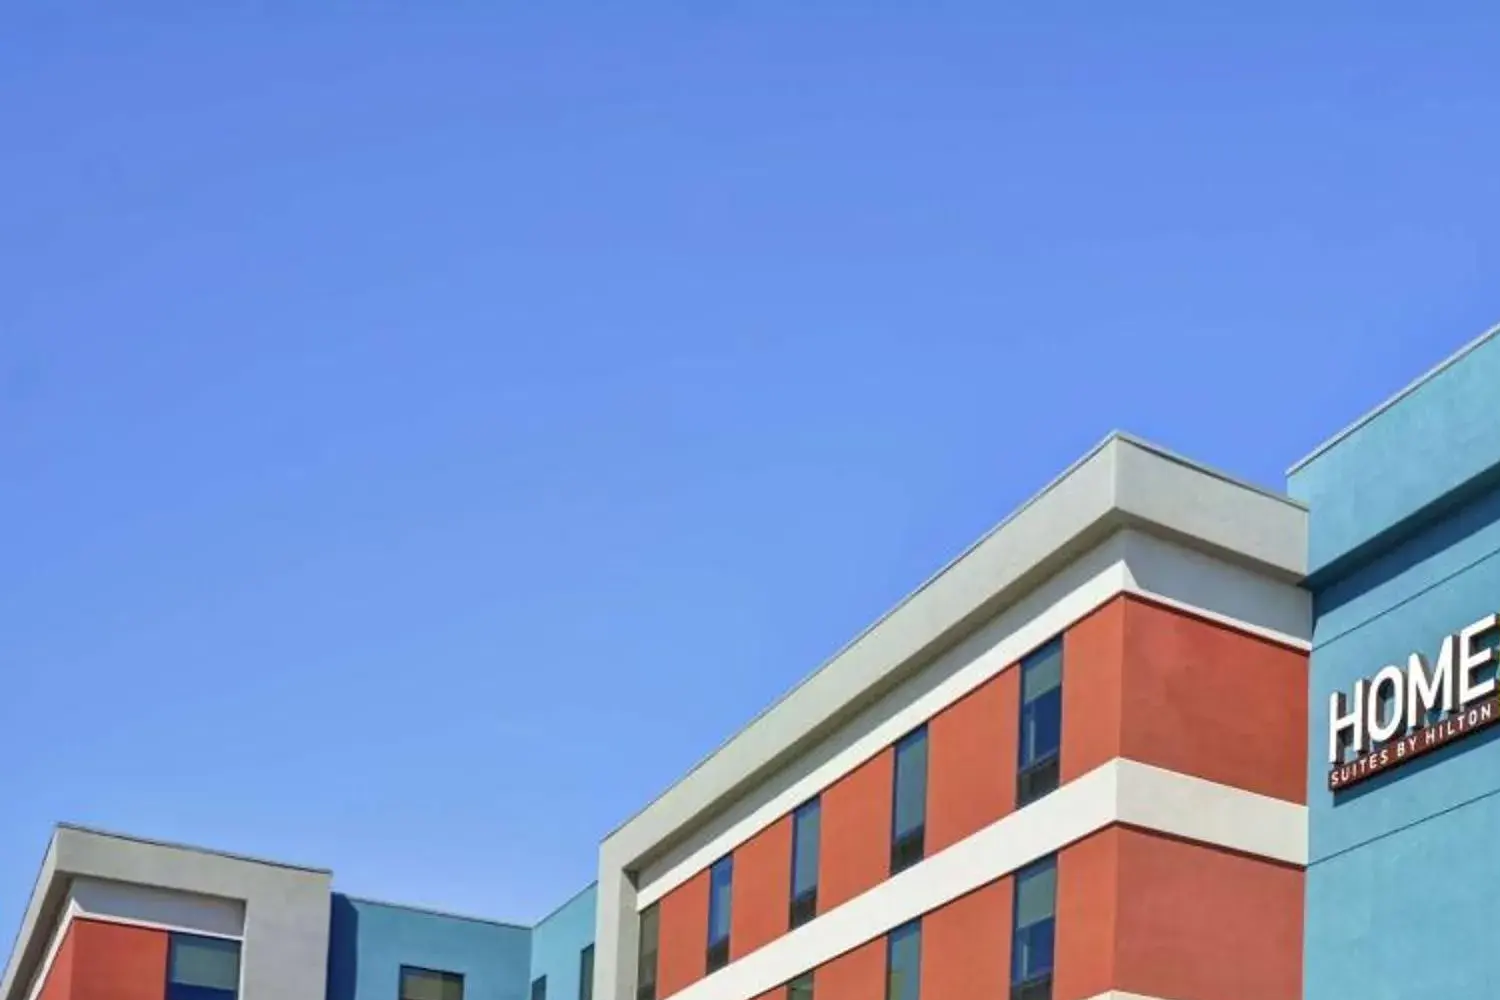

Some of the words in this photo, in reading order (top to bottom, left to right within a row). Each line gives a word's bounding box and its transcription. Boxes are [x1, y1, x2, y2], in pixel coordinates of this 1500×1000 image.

[1327, 612, 1498, 763] HOME
[1331, 749, 1389, 785] SUITES
[1396, 735, 1418, 758] BY
[1425, 703, 1492, 745] HILTON
